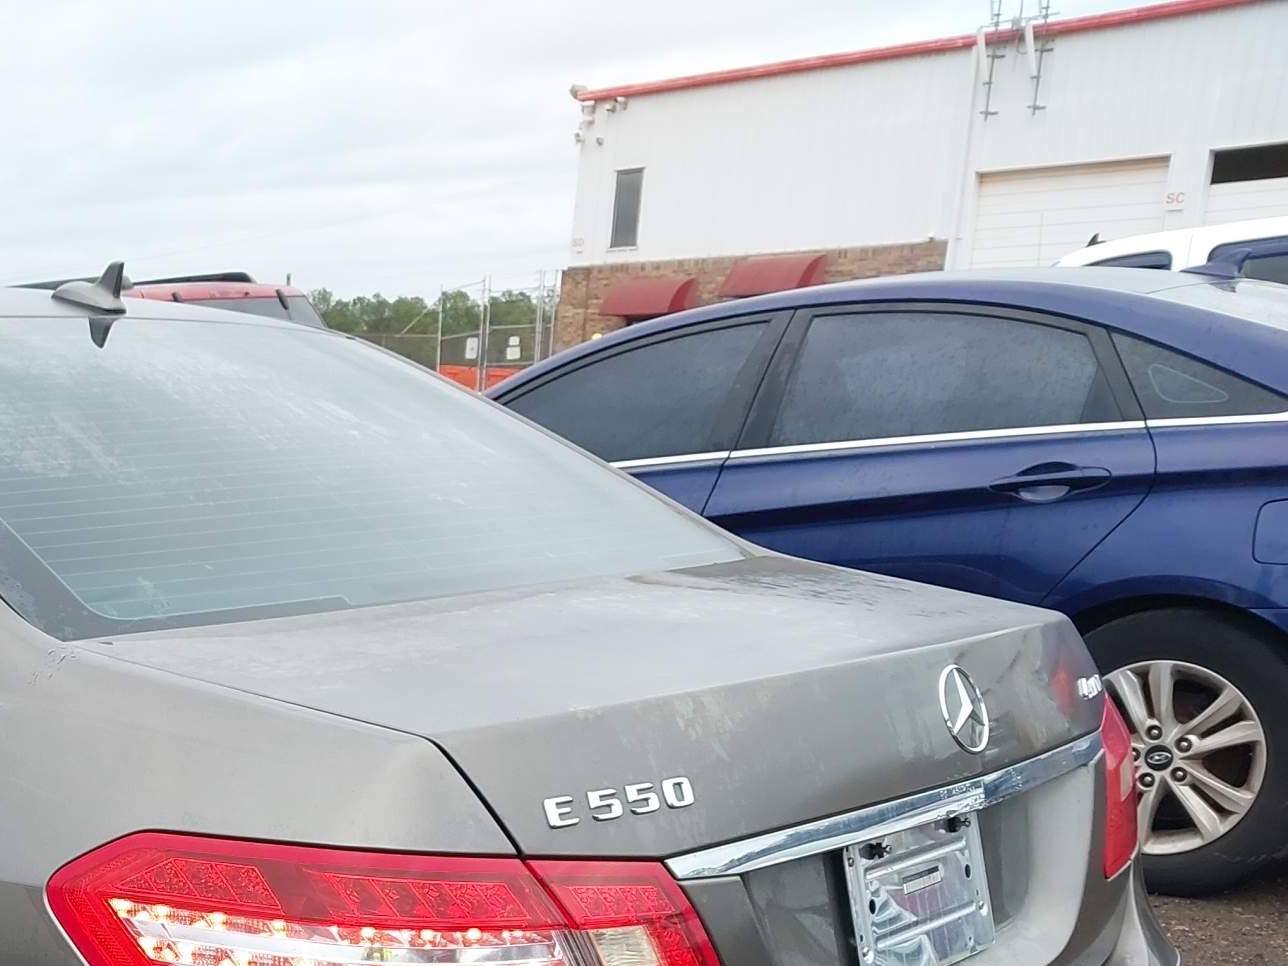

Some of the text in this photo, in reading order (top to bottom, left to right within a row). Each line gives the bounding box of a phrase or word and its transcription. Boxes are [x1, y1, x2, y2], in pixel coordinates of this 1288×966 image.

[1165, 191, 1185, 204] SC
[543, 776, 696, 829] E 550
